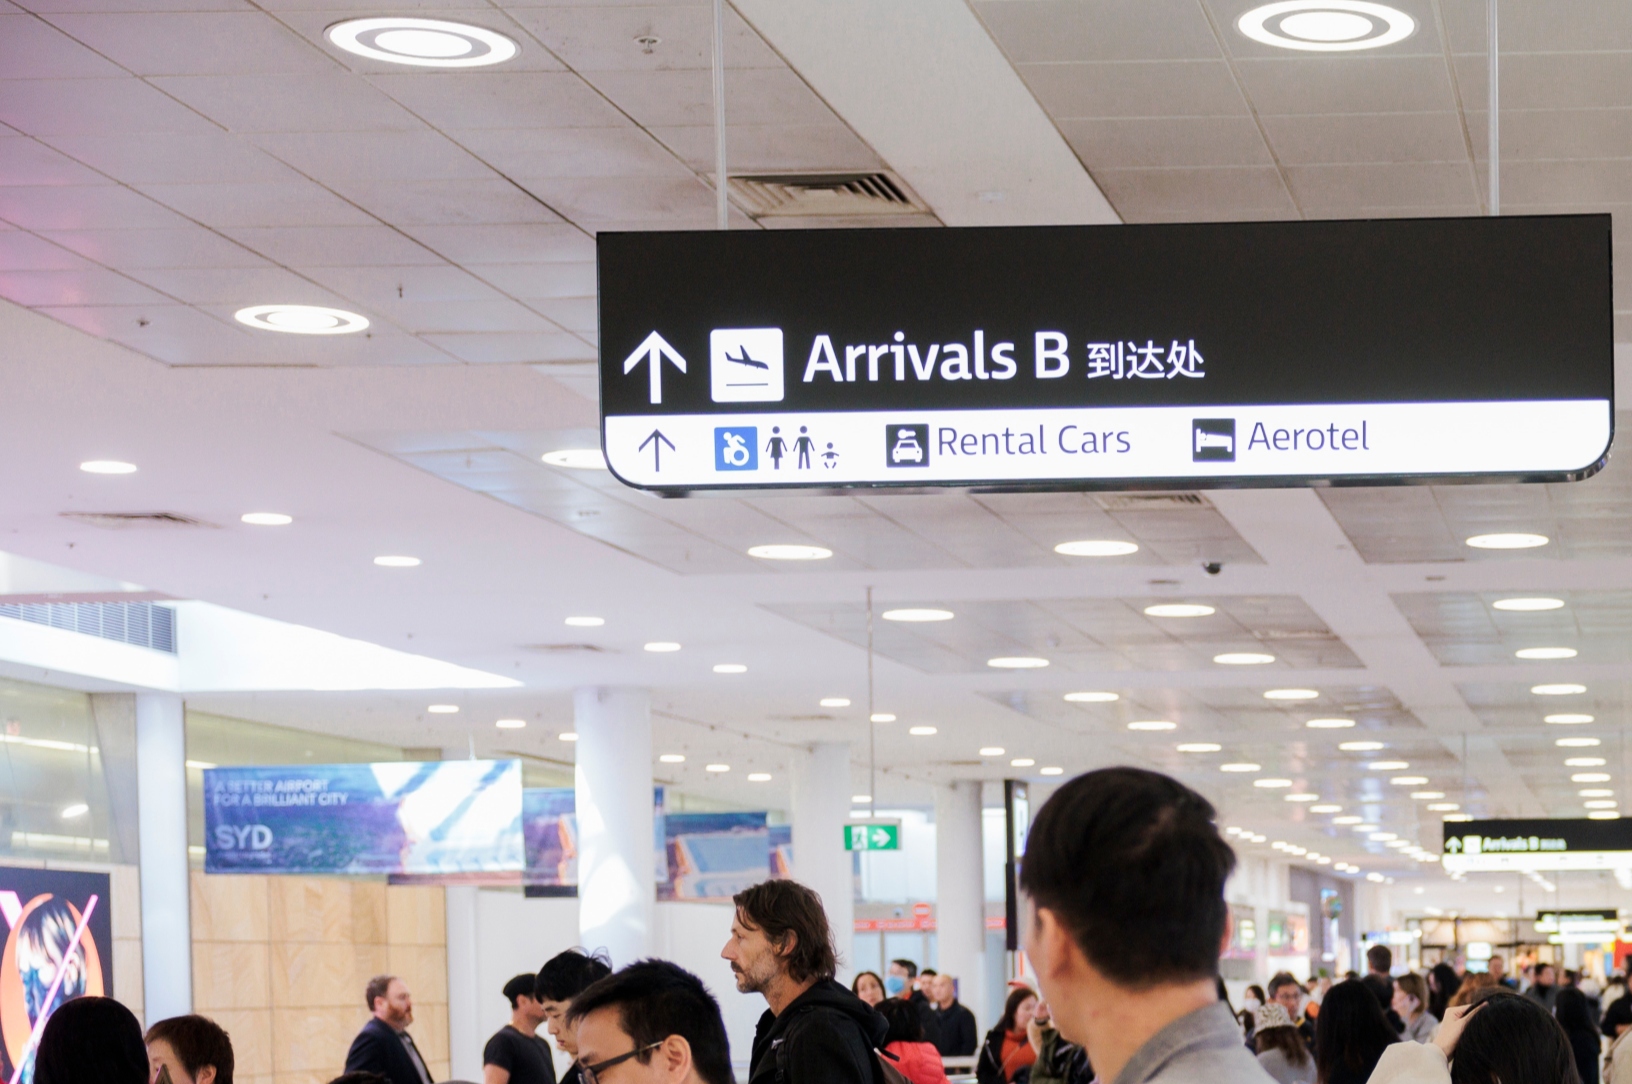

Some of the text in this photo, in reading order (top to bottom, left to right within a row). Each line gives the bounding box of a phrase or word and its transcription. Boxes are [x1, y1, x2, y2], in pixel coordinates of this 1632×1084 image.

[803, 329, 1071, 385] Arrivals B
[1085, 339, 1206, 381] 到达处
[937, 421, 1132, 457] Rental Cars
[1247, 418, 1370, 453] Aerotel
[227, 780, 274, 793] BETTER
[274, 778, 329, 793] AIRPORT
[253, 792, 317, 807] BRILLIANT
[318, 792, 350, 806] CITY
[214, 823, 274, 851] SYD
[1482, 835, 1528, 852] Arrivals
